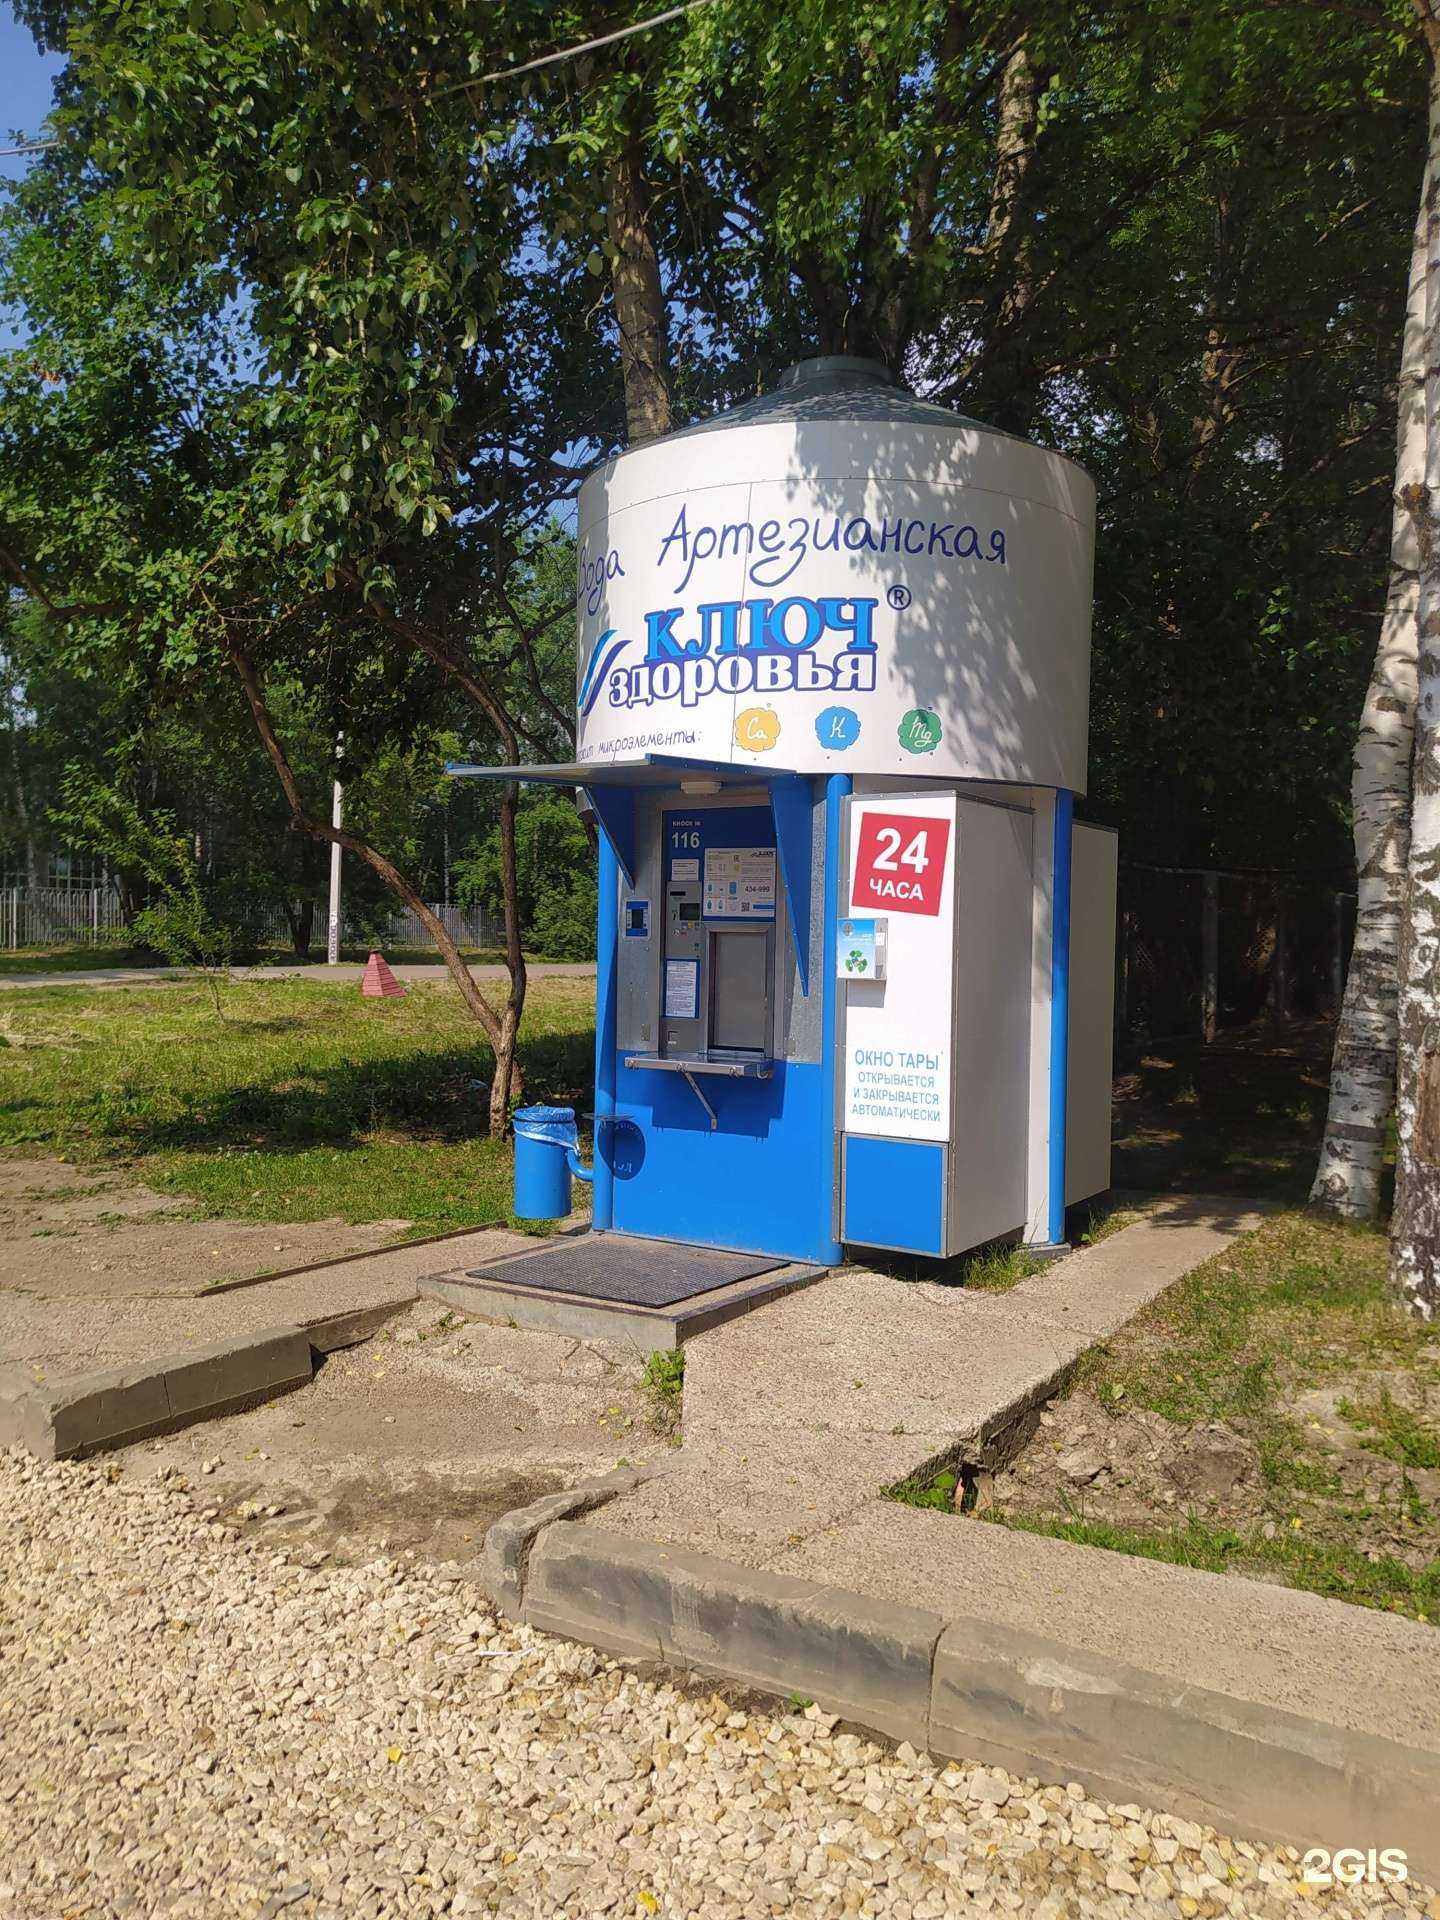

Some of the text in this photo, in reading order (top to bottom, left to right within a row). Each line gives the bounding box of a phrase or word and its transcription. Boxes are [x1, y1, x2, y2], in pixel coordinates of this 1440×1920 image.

[657, 503, 1007, 594] Артезианская
[598, 730, 703, 762] микроэлементы:
[672, 832, 700, 849] 116
[873, 828, 929, 874] 24
[869, 879, 924, 901] ЧАСА
[855, 1049, 939, 1071] ОКНО ТАРЫ
[858, 1071, 935, 1088] ОТКРЫВАЕТСЯ
[853, 1087, 939, 1105] И ЗАКРЫВАЕТСЯ
[852, 1104, 940, 1122] АВТОМАТИЧЕСКИ
